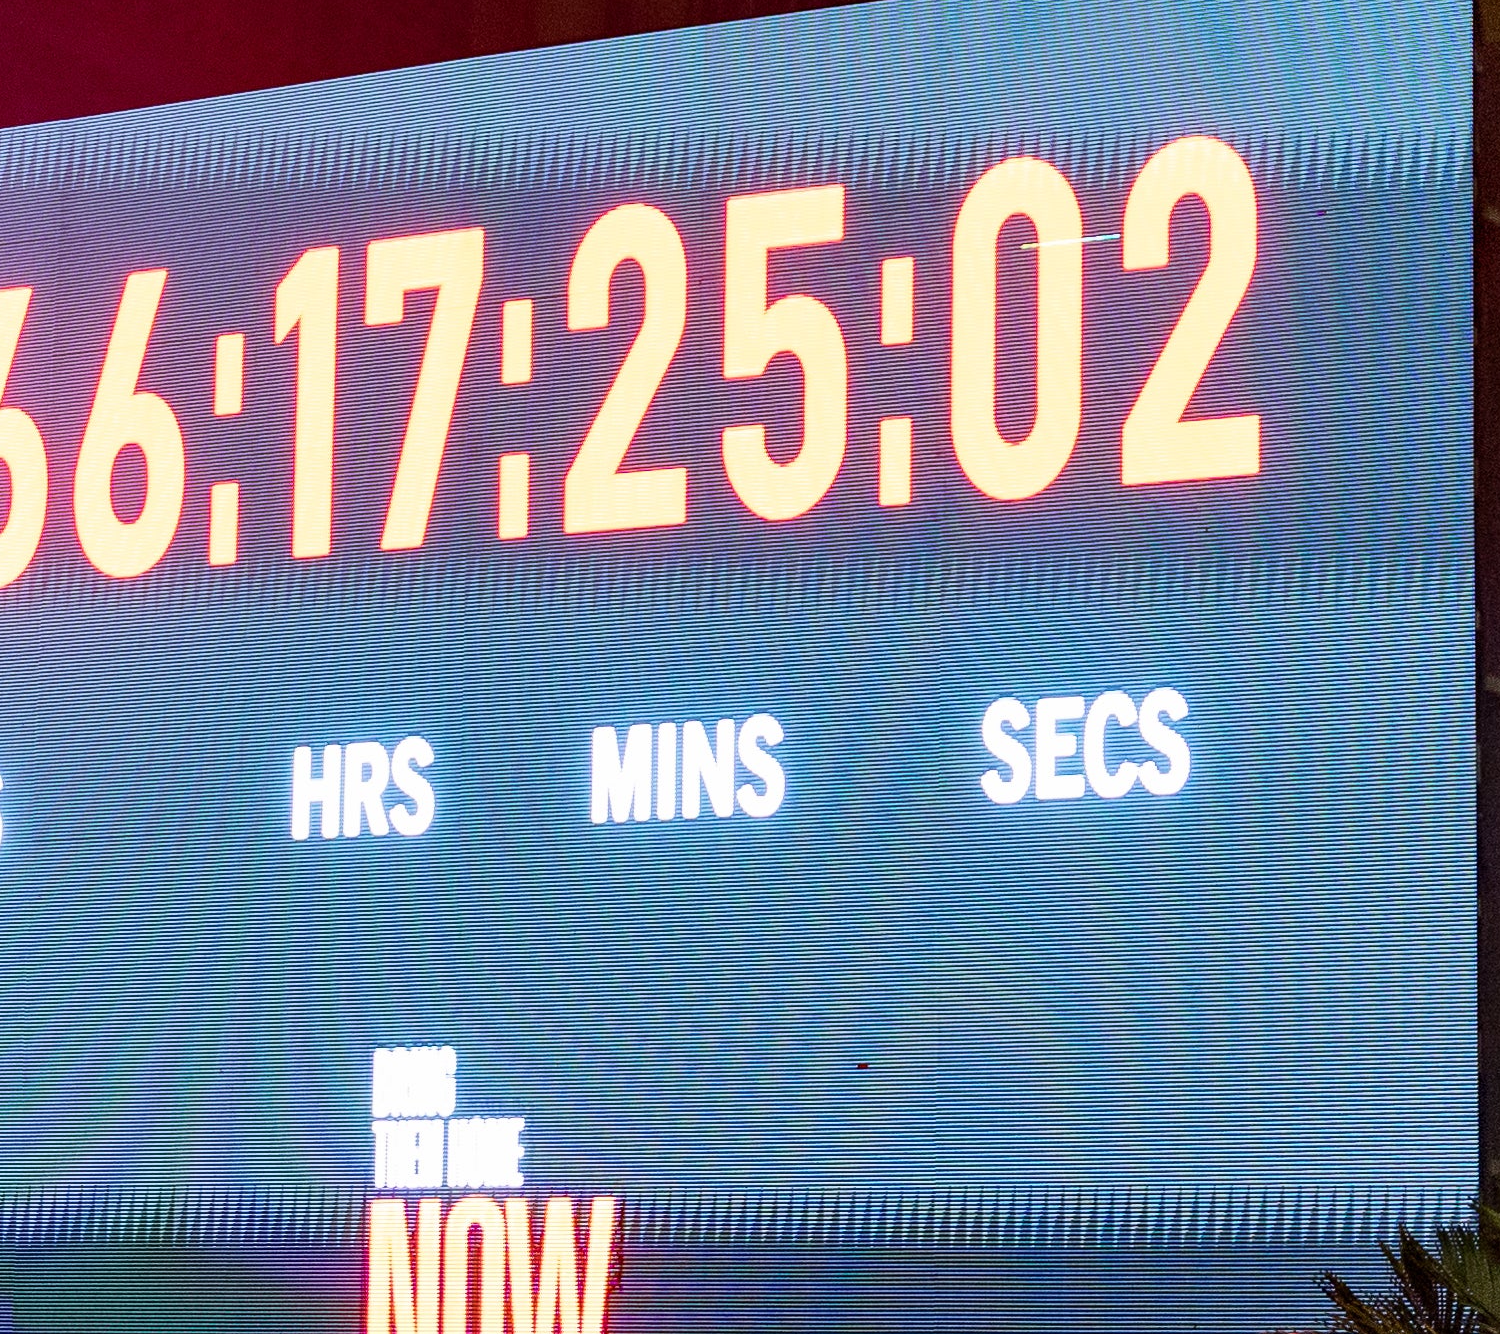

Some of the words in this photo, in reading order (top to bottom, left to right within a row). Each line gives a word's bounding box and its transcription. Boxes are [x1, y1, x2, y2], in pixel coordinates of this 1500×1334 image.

[291, 736, 435, 840] HRS
[590, 714, 785, 823] MINS
[980, 688, 1190, 804] SECS
